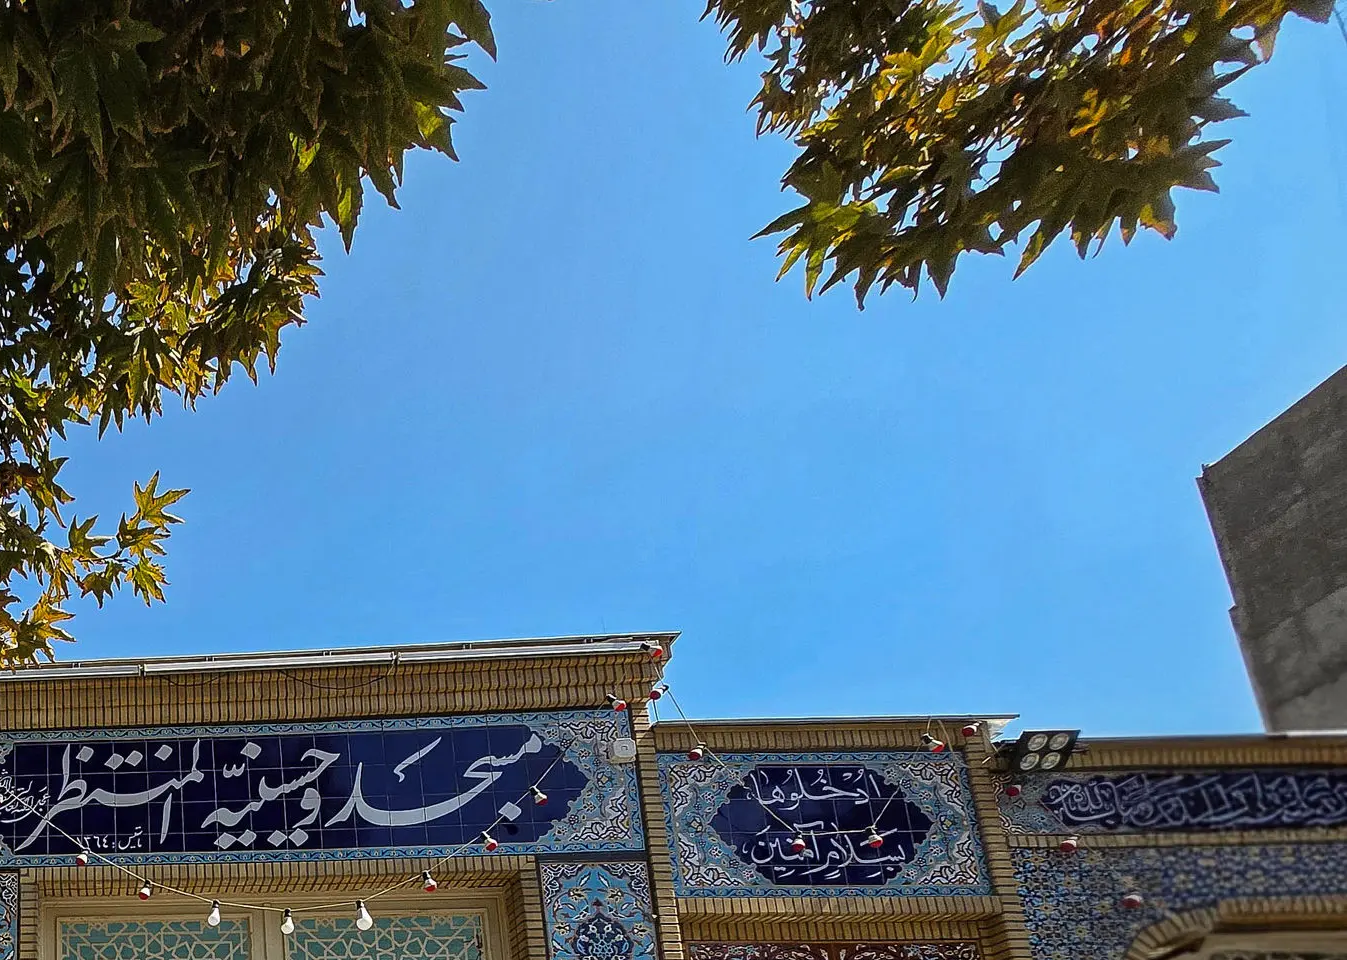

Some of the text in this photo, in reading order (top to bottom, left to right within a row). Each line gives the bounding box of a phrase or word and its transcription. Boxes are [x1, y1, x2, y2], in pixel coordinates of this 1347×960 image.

[15, 738, 205, 853] المنتظر
[293, 787, 322, 829] و
[325, 733, 542, 828] مسجد
